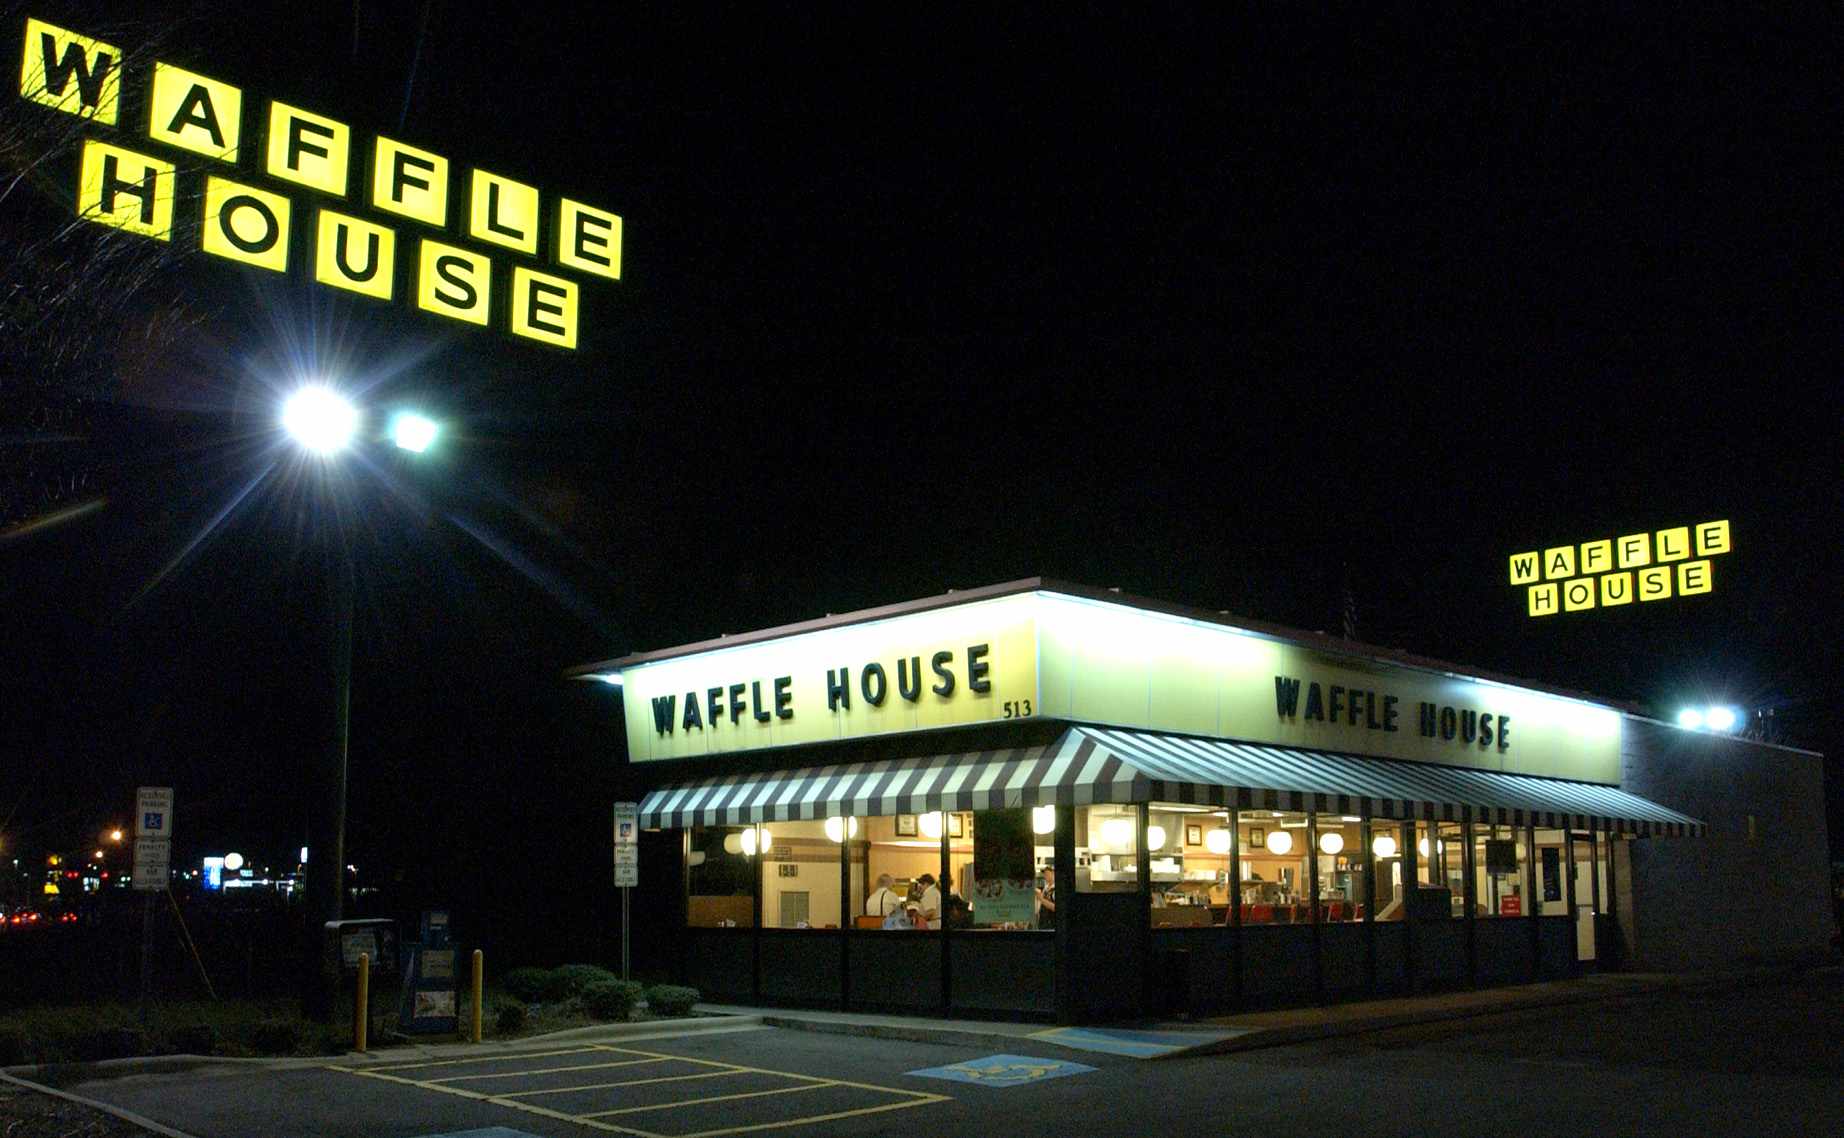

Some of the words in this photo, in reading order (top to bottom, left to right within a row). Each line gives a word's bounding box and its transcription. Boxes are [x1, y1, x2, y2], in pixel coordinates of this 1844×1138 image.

[40, 32, 612, 267] WAFFLE
[100, 155, 567, 337] HOUSE
[1514, 526, 1722, 579] WAFFLE
[1535, 566, 1703, 610] HOUSE
[651, 675, 794, 735] WAFFLE
[826, 643, 992, 712] HOUSE
[1003, 699, 1032, 719] 513
[1275, 676, 1399, 732] WAFFLE
[1420, 701, 1510, 748] HOUSE
